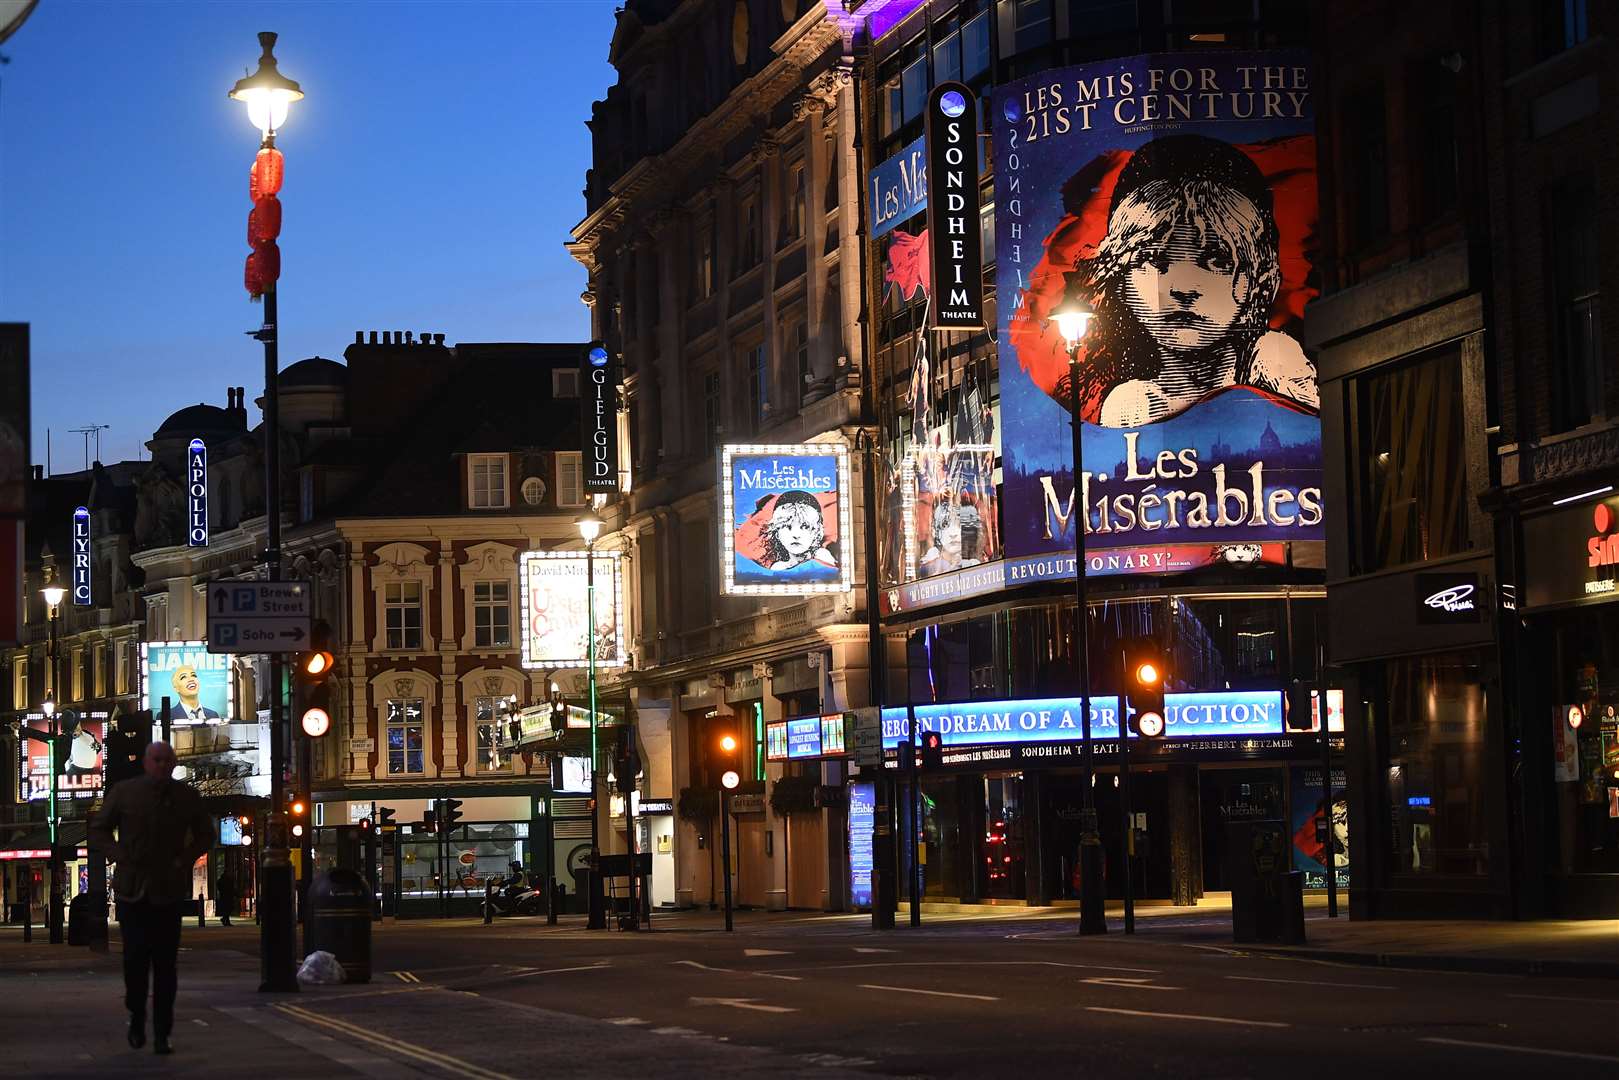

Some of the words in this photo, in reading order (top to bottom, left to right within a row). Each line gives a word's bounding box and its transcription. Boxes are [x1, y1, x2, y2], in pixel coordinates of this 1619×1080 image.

[1024, 83, 1062, 115] LES
[1076, 71, 1134, 103] MIS
[1147, 67, 1222, 92] FOR
[1236, 66, 1310, 90] THE
[1025, 102, 1098, 143] 21ST
[1113, 91, 1311, 125] CENTURY
[873, 175, 899, 226] Les
[945, 122, 970, 306] SONDHEIM
[941, 311, 977, 319] THEATRE
[591, 368, 609, 476] GIELGUD
[1123, 431, 1199, 482] Les
[739, 468, 831, 490] Misérables
[772, 460, 795, 476] Les
[190, 454, 206, 542] APOLLO
[1039, 460, 1325, 540] Misérables
[75, 523, 89, 600] LYRIC
[532, 564, 562, 576] David
[263, 601, 304, 613] Street
[242, 629, 275, 640] Soho
[149, 652, 226, 671] JAMIE
[939, 710, 1011, 733] DREAM
[1019, 710, 1051, 731] OF
[1058, 710, 1076, 729] A
[1021, 745, 1072, 757] SONDHEIM
[1190, 740, 1236, 751] HERBERT
[29, 774, 102, 791] THILLER
